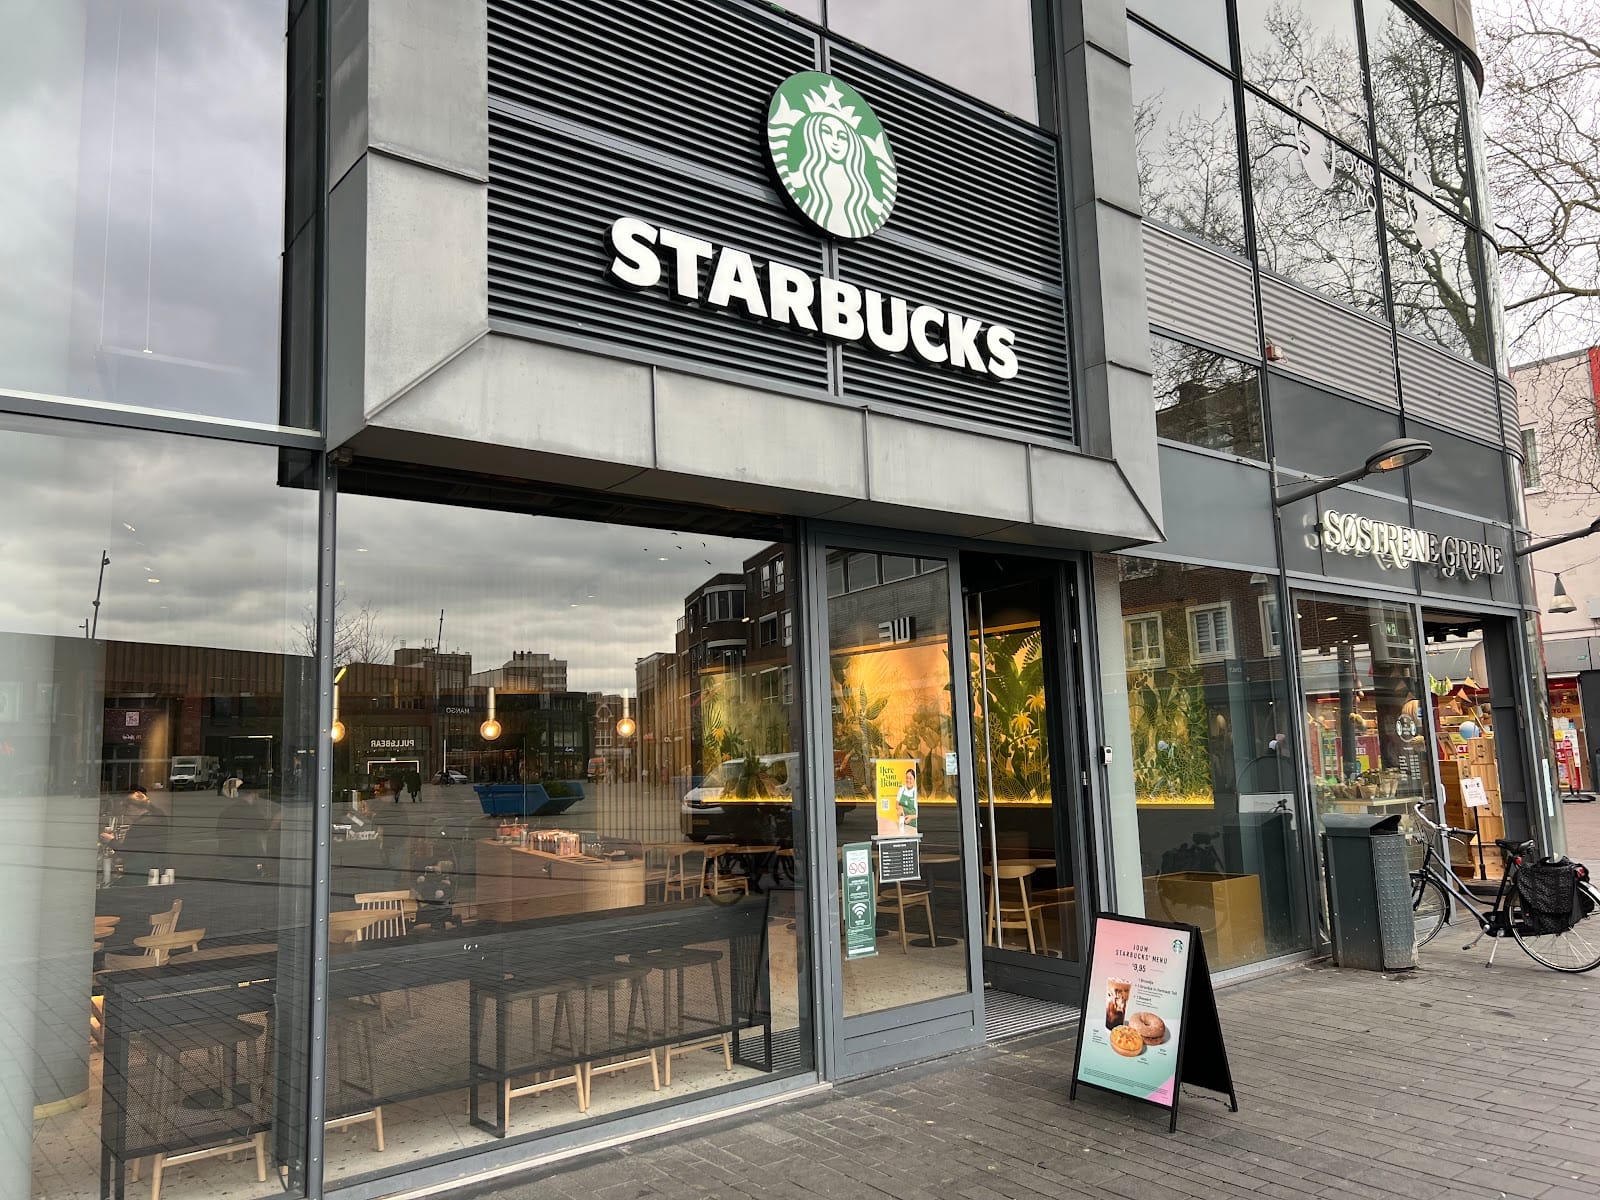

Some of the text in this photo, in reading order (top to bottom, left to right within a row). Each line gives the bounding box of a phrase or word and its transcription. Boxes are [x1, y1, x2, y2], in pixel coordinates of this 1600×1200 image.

[608, 216, 1019, 381] STARBUCKS
[1323, 510, 1504, 581] SØSTRENE GRENE
[1152, 956, 1168, 965] MENU
